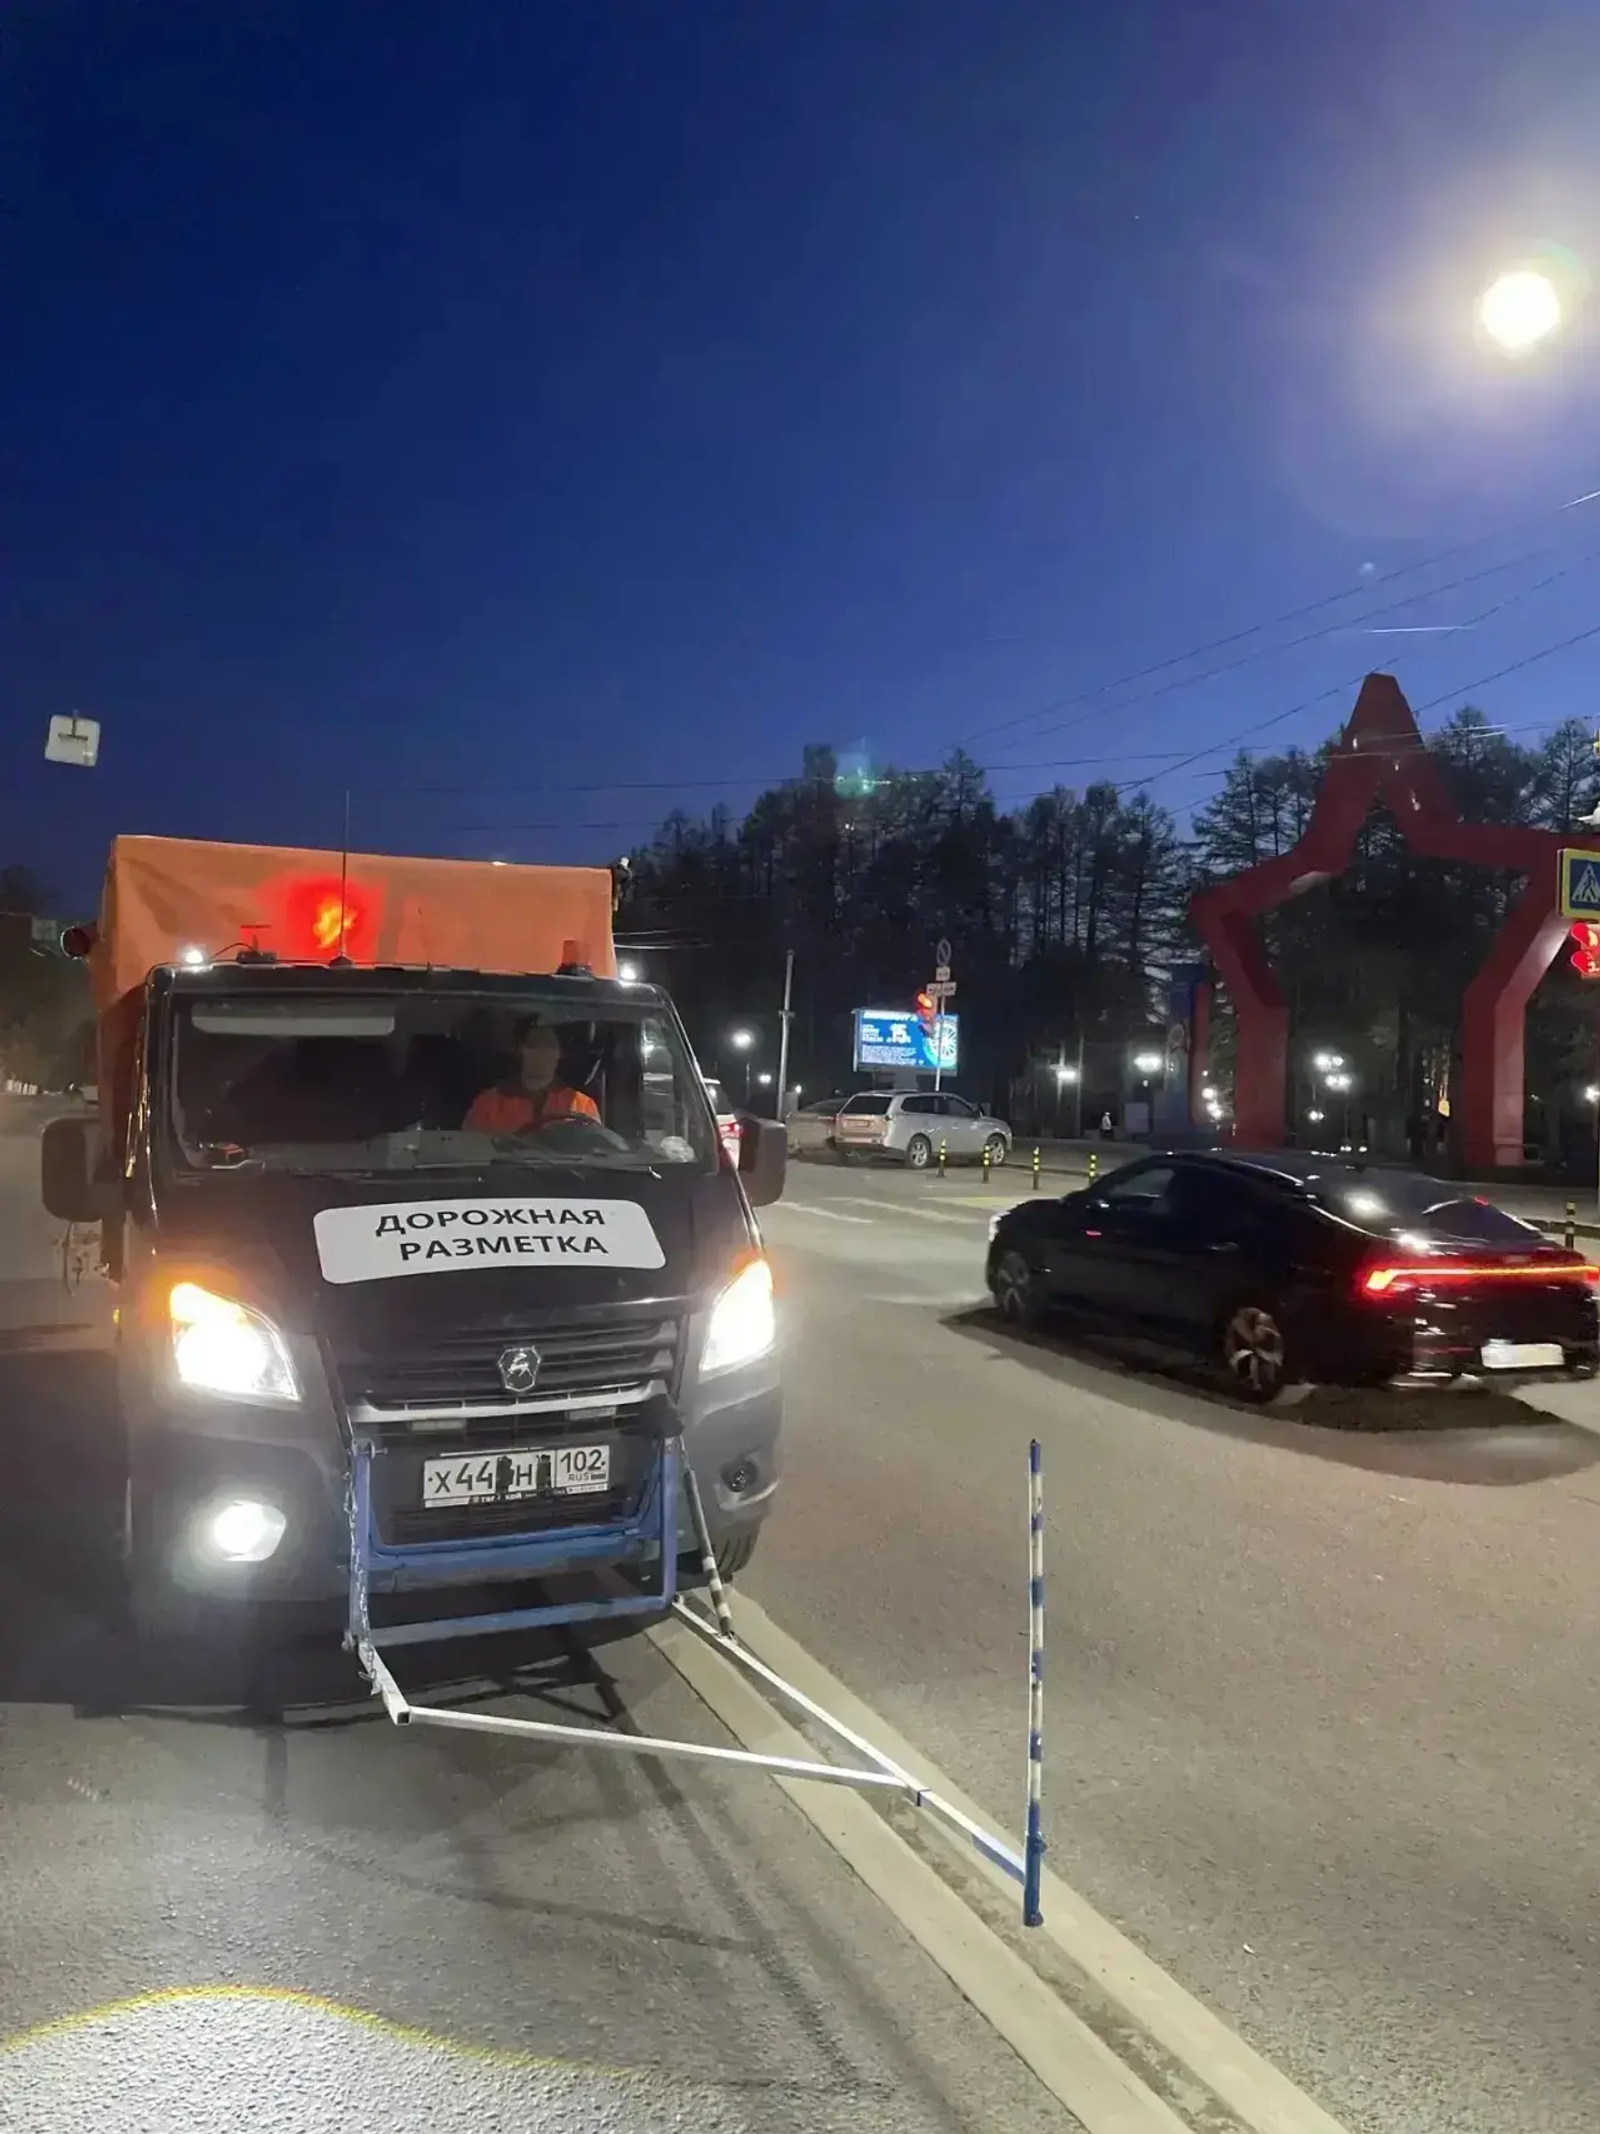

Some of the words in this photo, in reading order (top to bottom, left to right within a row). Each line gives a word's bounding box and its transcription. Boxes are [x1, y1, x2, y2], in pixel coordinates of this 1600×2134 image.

[375, 1209, 605, 1237] ДОРОЖНАЯ
[400, 1235, 610, 1261] РАЗМЕТКА
[560, 1449, 602, 1473] 102
[568, 1473, 590, 1482] RUS
